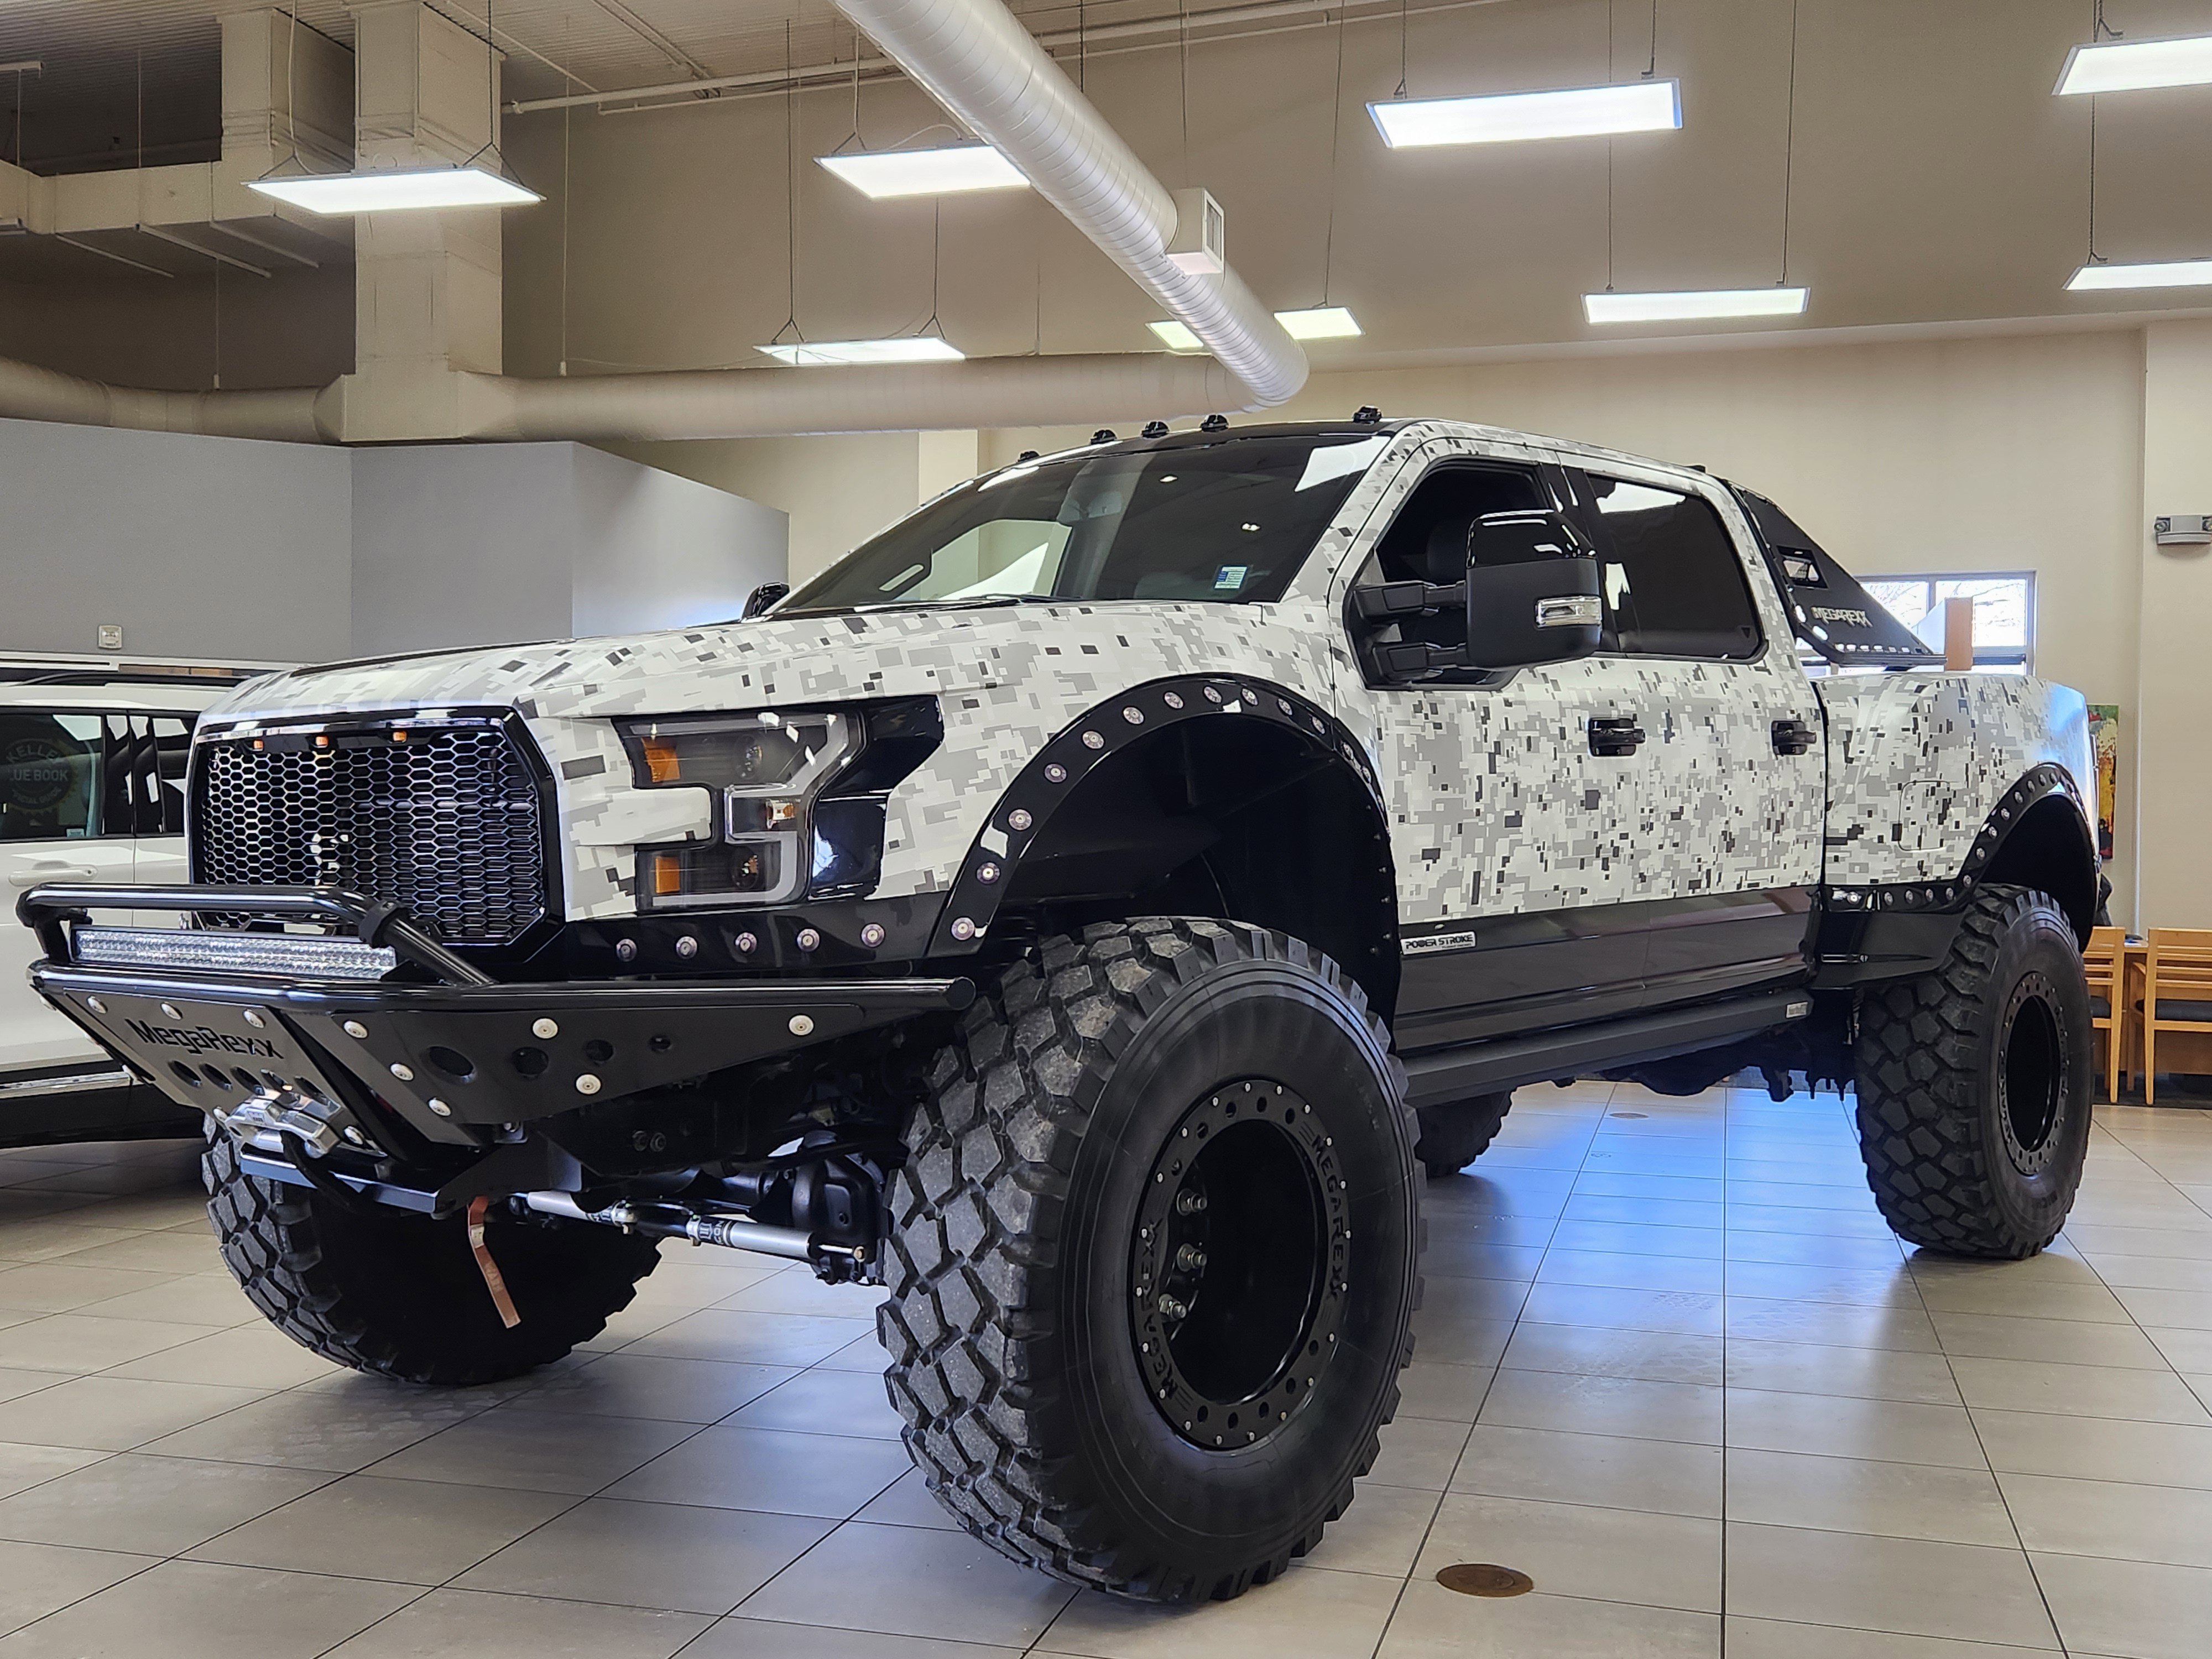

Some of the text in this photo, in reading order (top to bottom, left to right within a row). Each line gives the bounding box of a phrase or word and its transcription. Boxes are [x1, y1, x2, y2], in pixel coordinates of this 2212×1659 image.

[1811, 607, 1873, 628] MEGAREXX
[7, 744, 59, 763] KELLE
[34, 769, 68, 782] BOOK
[1405, 939, 1436, 949] POWER
[1438, 935, 1473, 945] STROKE
[1312, 1134, 1345, 1300] MEGAREXX
